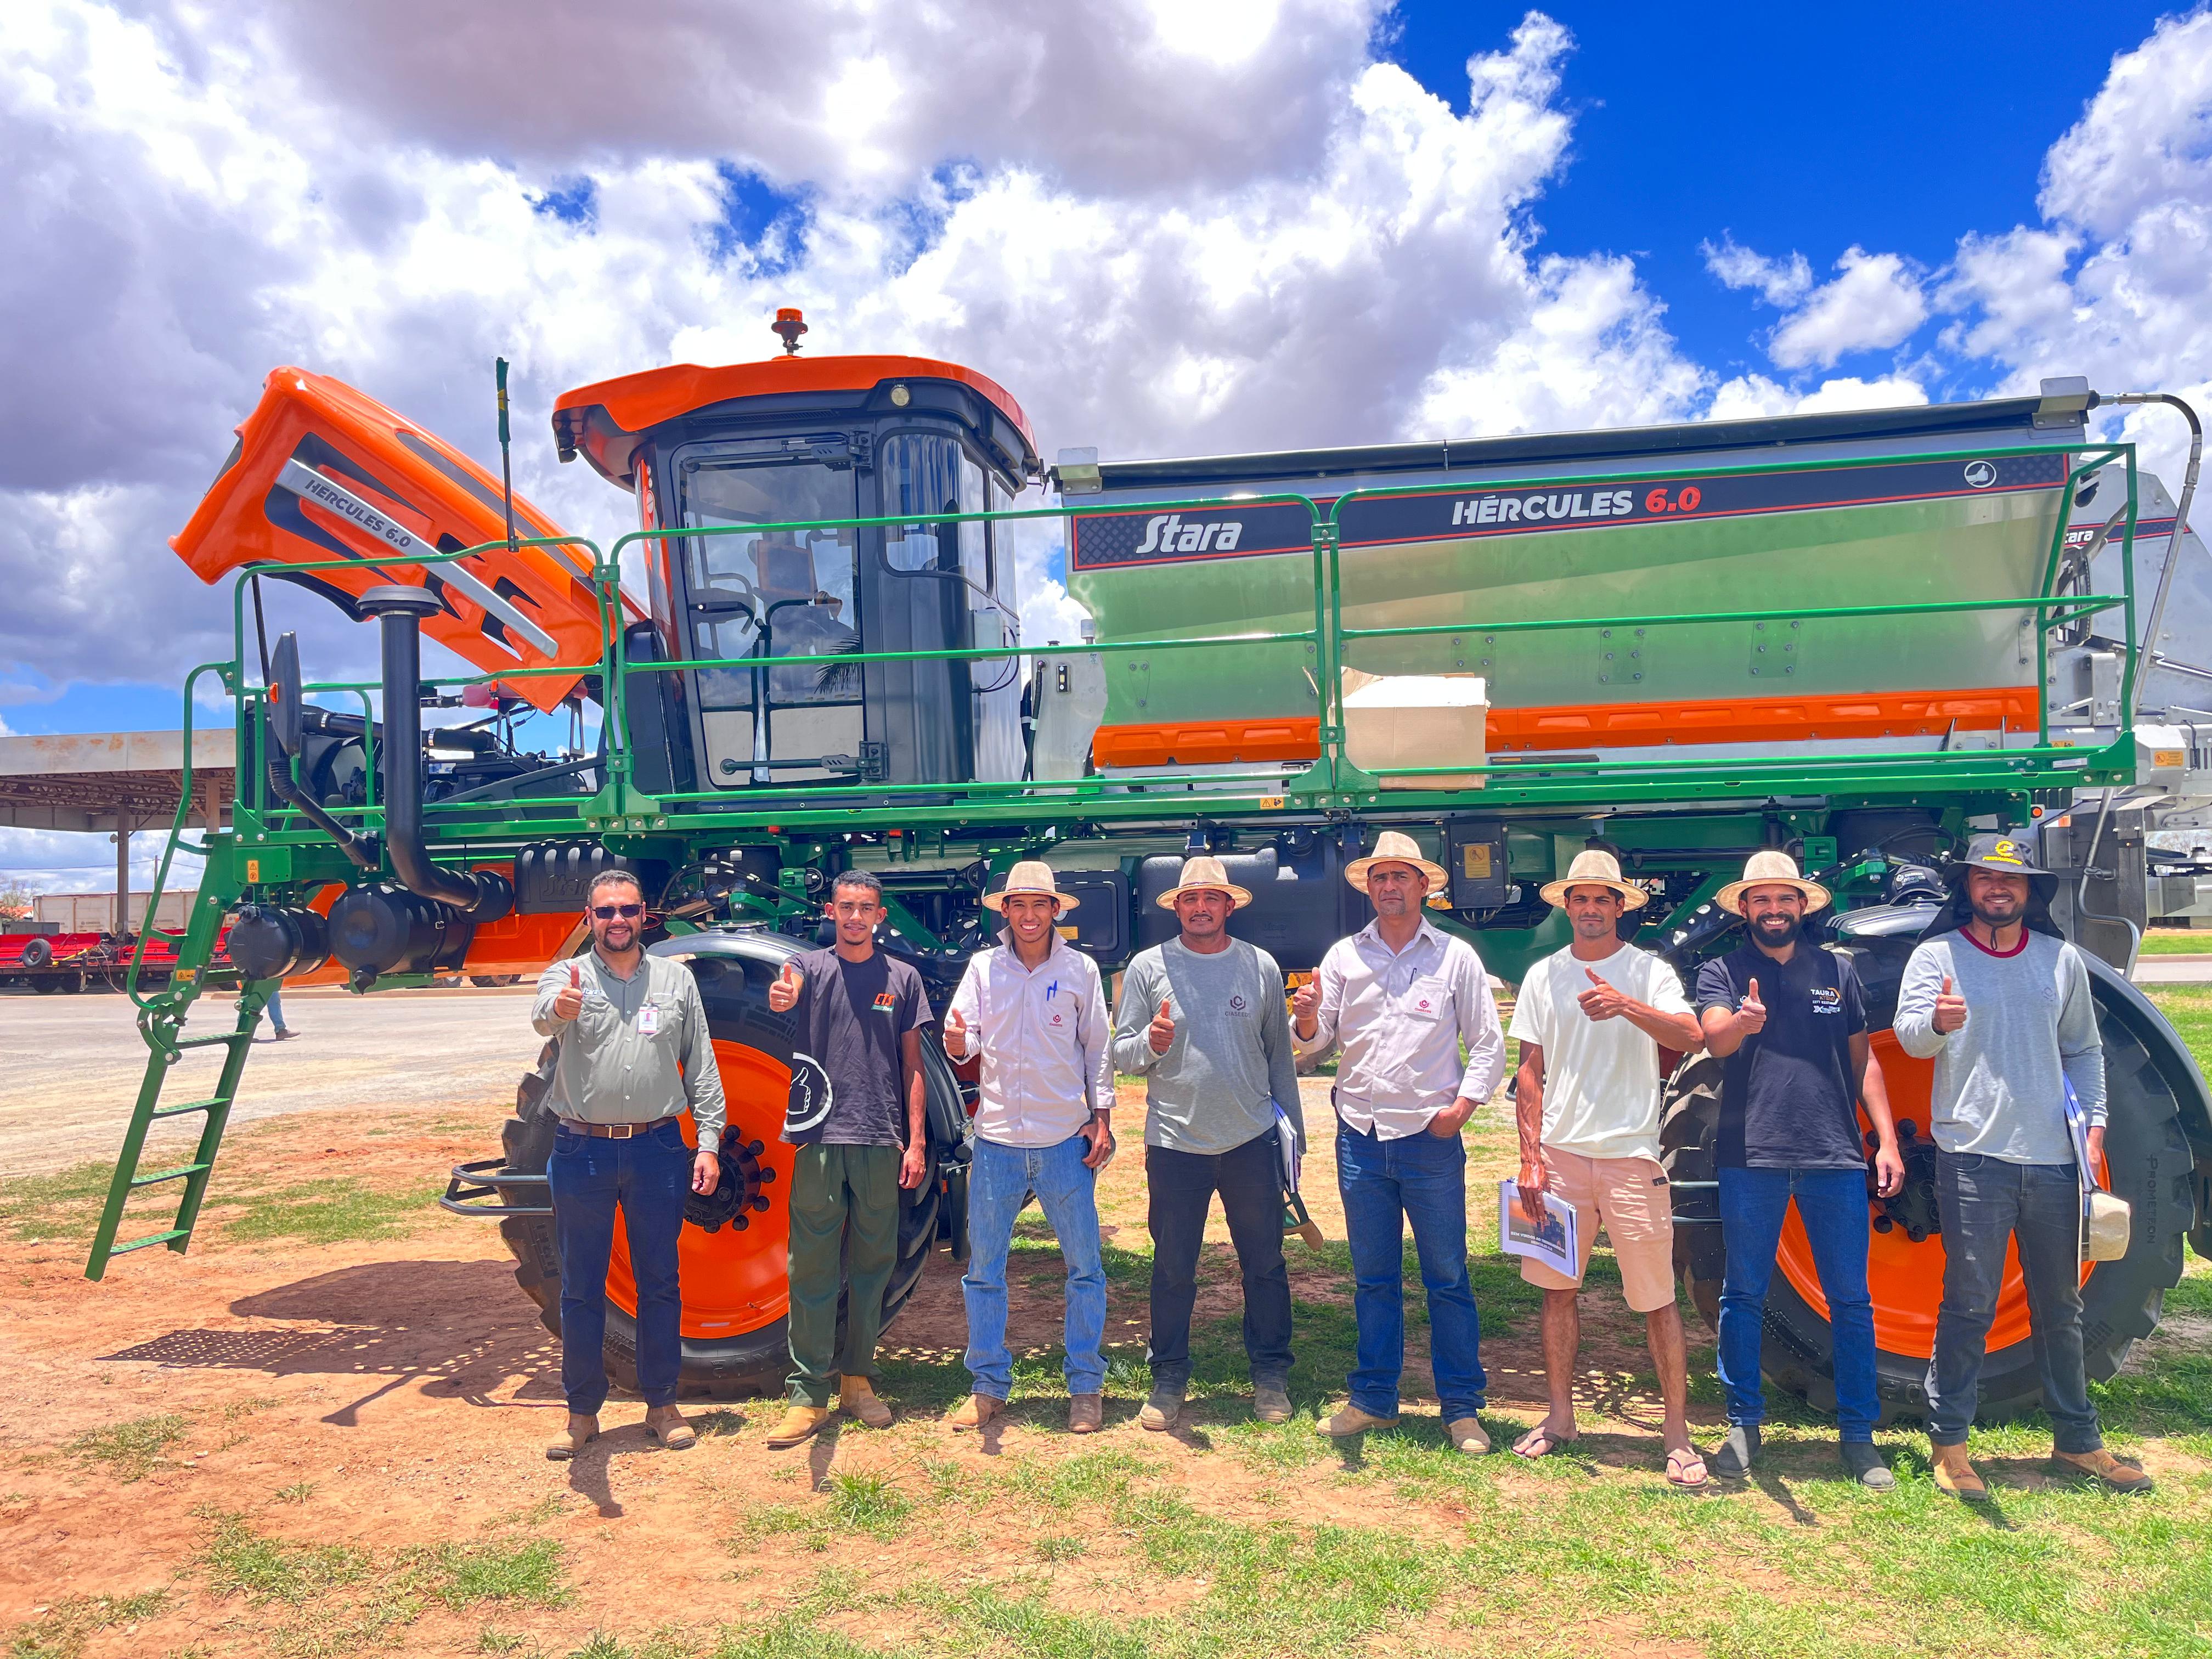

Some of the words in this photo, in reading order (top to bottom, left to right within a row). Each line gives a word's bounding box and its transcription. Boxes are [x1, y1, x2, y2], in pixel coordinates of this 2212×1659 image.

[1452, 490, 1633, 526] HÉRCULES
[1645, 486, 1701, 513] 6.0
[386, 528, 411, 547] 6.0
[1136, 515, 1243, 554] Stara
[543, 873, 591, 896] Star
[874, 993, 896, 1006] CTS
[2146, 1154, 2159, 1244] PROMETEON
